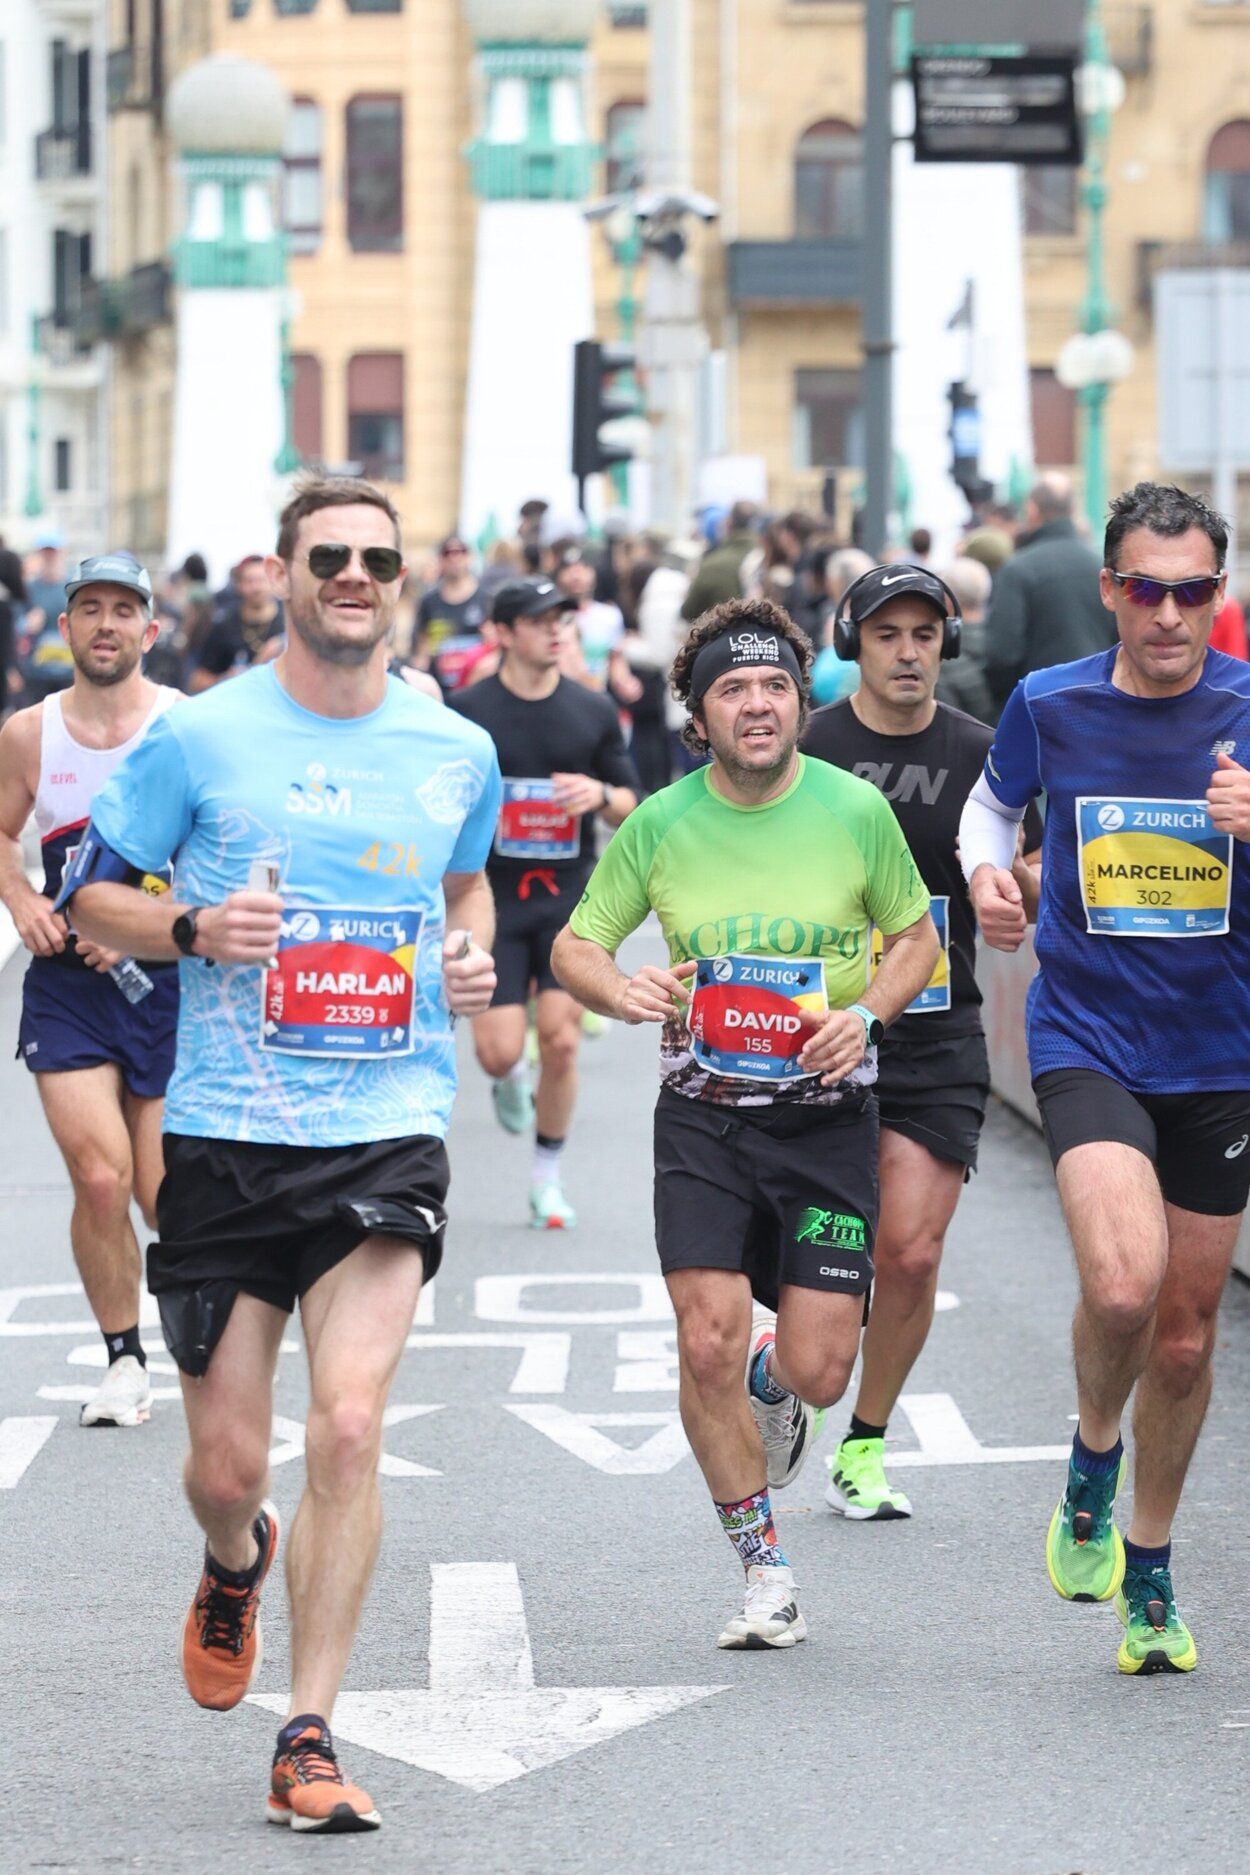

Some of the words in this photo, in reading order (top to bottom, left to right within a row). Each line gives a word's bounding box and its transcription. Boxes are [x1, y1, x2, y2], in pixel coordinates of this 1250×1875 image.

[729, 633, 778, 647] LOLA
[733, 654, 760, 663] PUERTO
[1132, 811, 1206, 828] ZURICH
[357, 840, 420, 877] 42k
[1097, 864, 1223, 881] MARCELINO
[1136, 889, 1172, 905] 302
[296, 971, 405, 996] HARLAN
[324, 1004, 375, 1024] 2339
[724, 1008, 801, 1034] DAVID
[744, 1037, 772, 1053] 155
